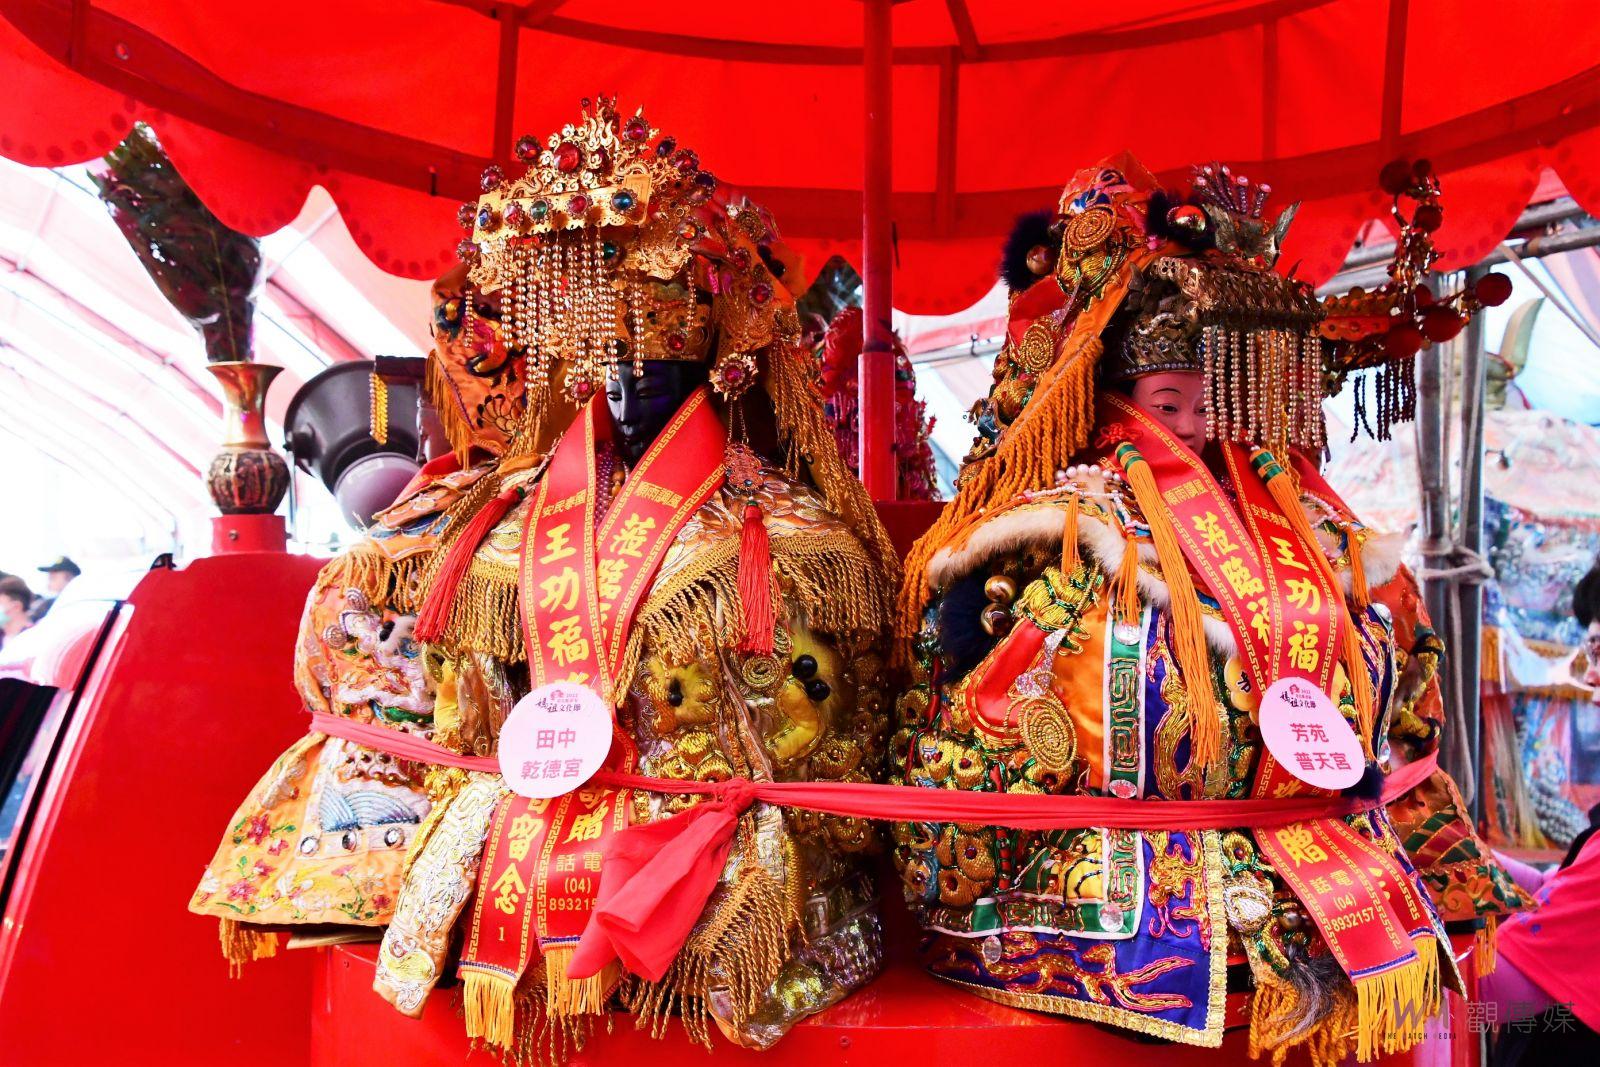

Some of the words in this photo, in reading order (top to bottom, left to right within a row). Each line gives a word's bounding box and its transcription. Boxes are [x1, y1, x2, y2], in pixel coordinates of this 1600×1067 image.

[598, 512, 657, 640] 蒞臨
[536, 728, 576, 749] 田中
[1290, 723, 1329, 742] 芳苑
[521, 759, 583, 780] 乾德宮
[1294, 751, 1352, 771] 普天宮
[564, 877, 591, 894] (04)
[1333, 892, 1357, 911] (04)
[1331, 907, 1374, 932] 8932157
